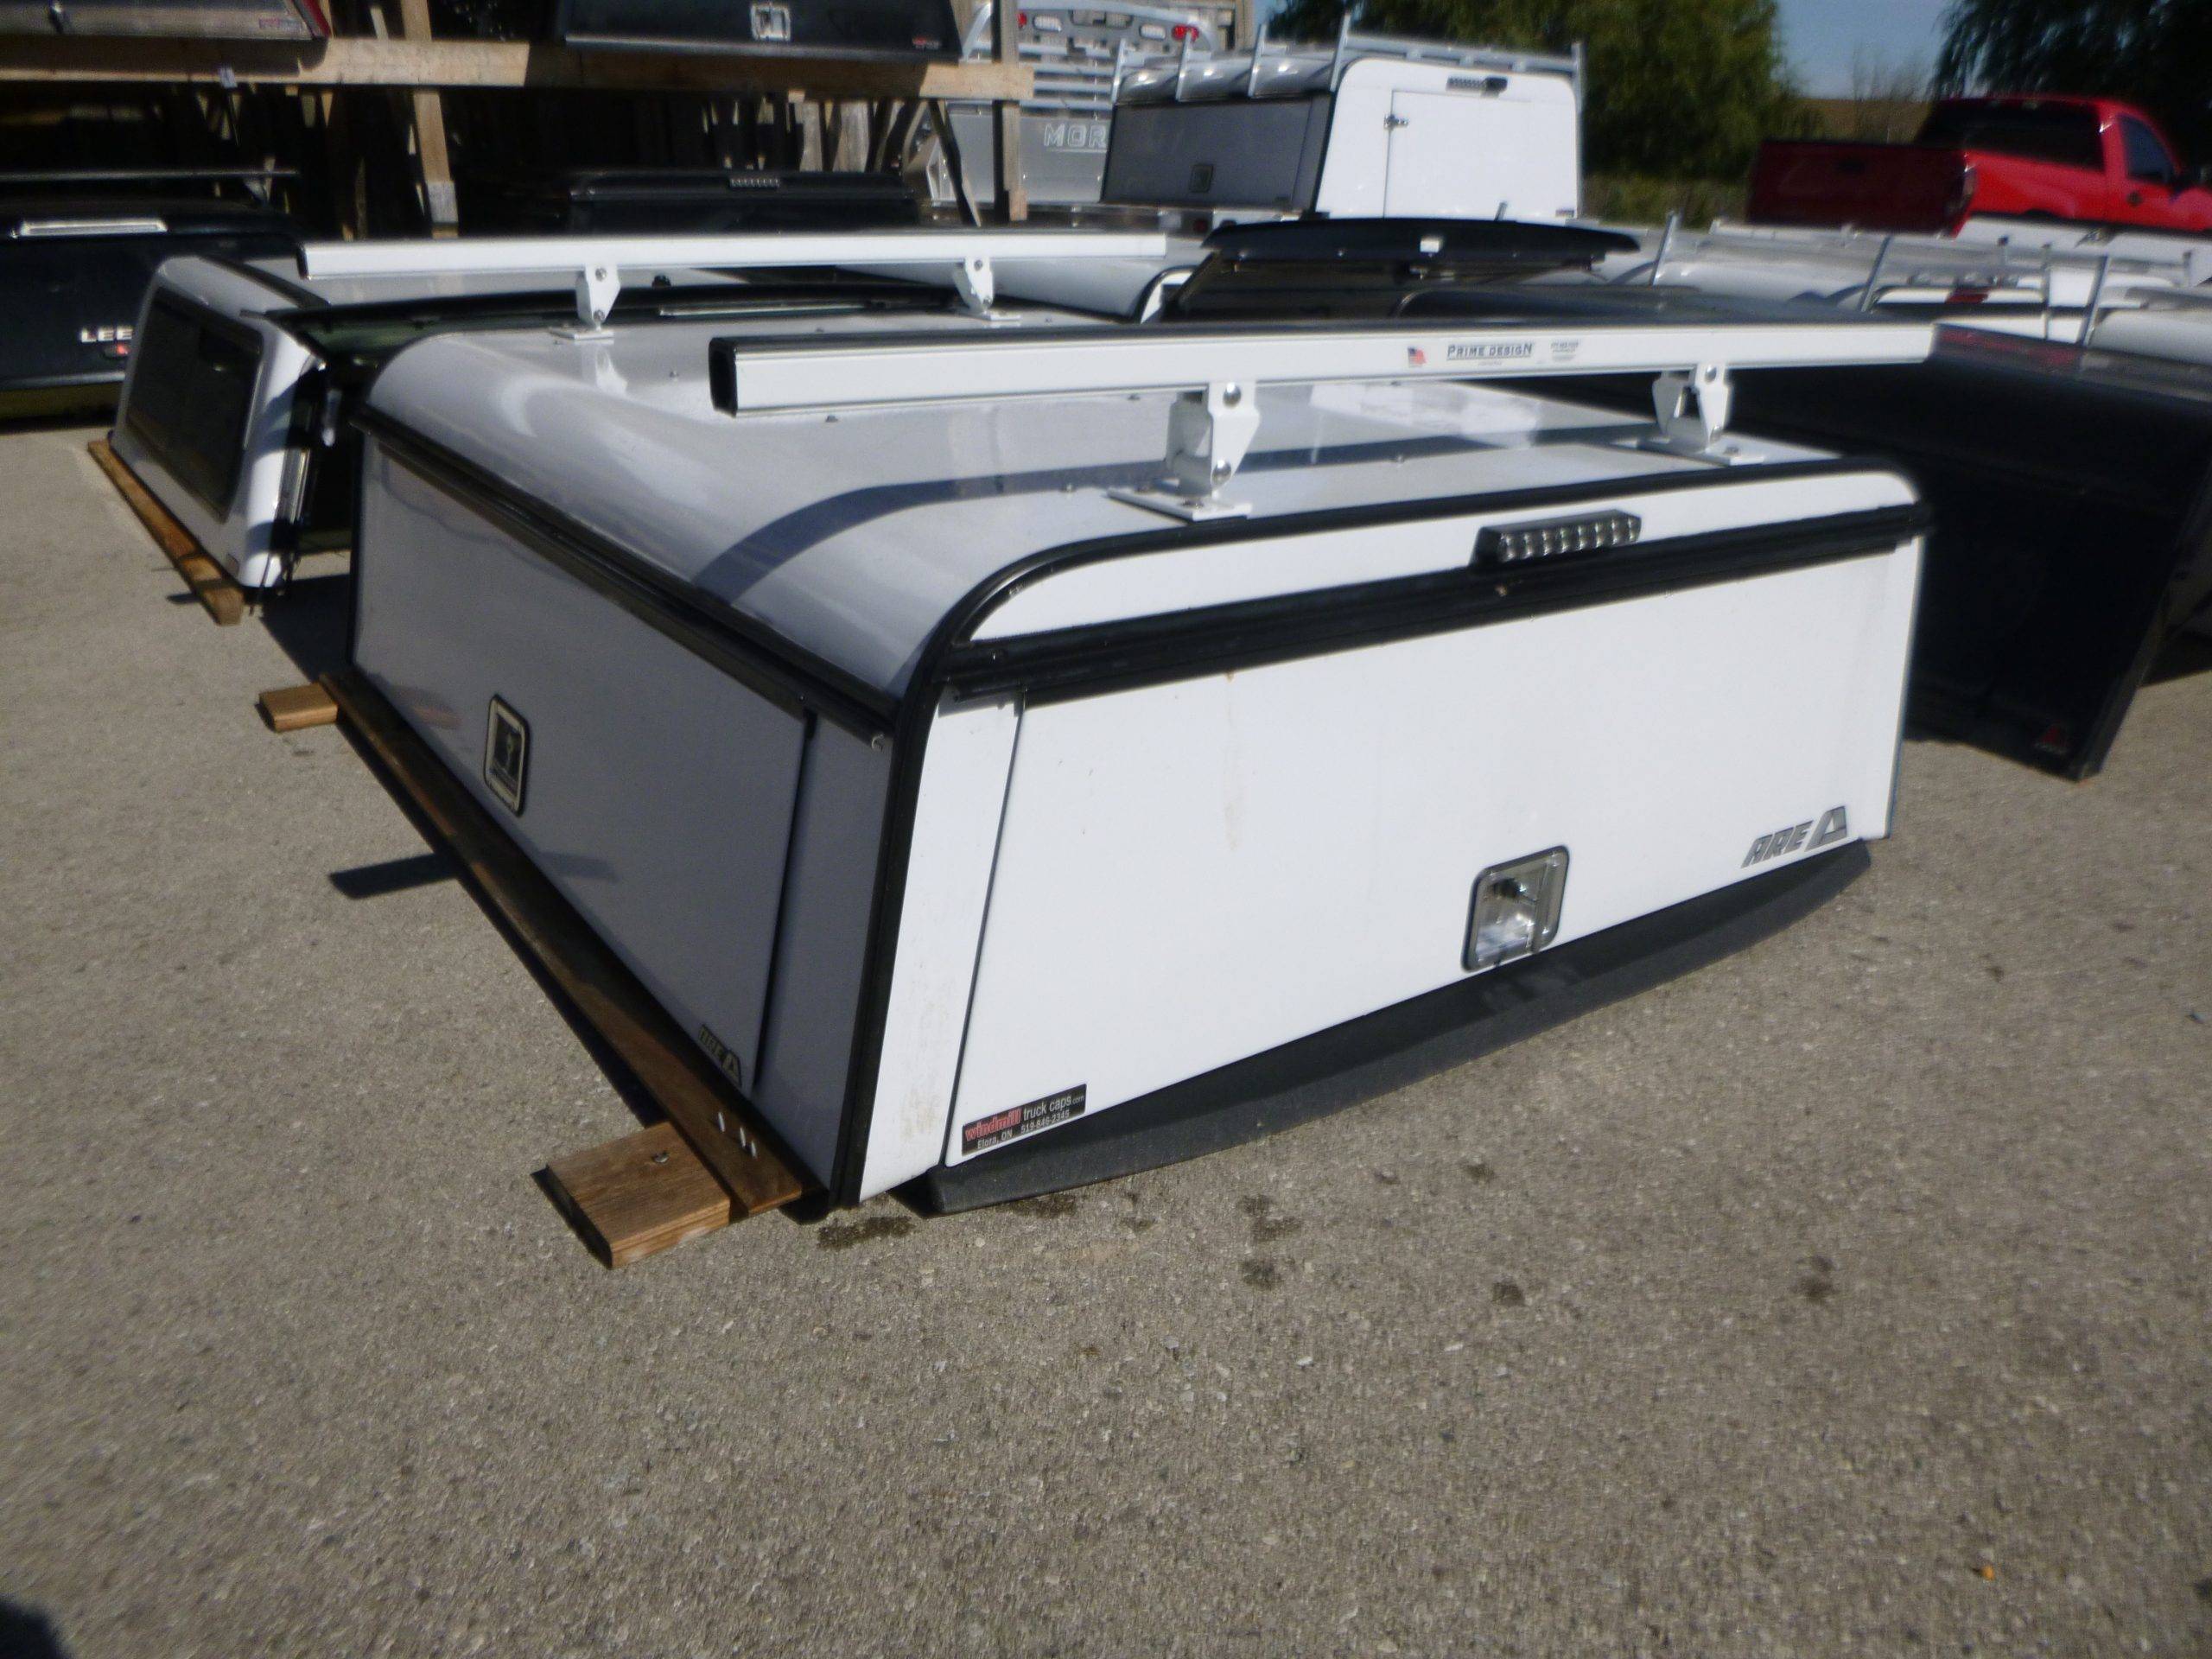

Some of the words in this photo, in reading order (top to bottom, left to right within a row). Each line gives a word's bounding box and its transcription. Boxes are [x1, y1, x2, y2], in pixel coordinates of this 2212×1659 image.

[1446, 344, 1485, 359] PRIME
[1489, 342, 1534, 357] DESIGN
[1741, 820, 1814, 868] ARE
[965, 1108, 1021, 1141] windmill
[1023, 1102, 1047, 1121] truck
[1001, 1128, 1013, 1140] ON
